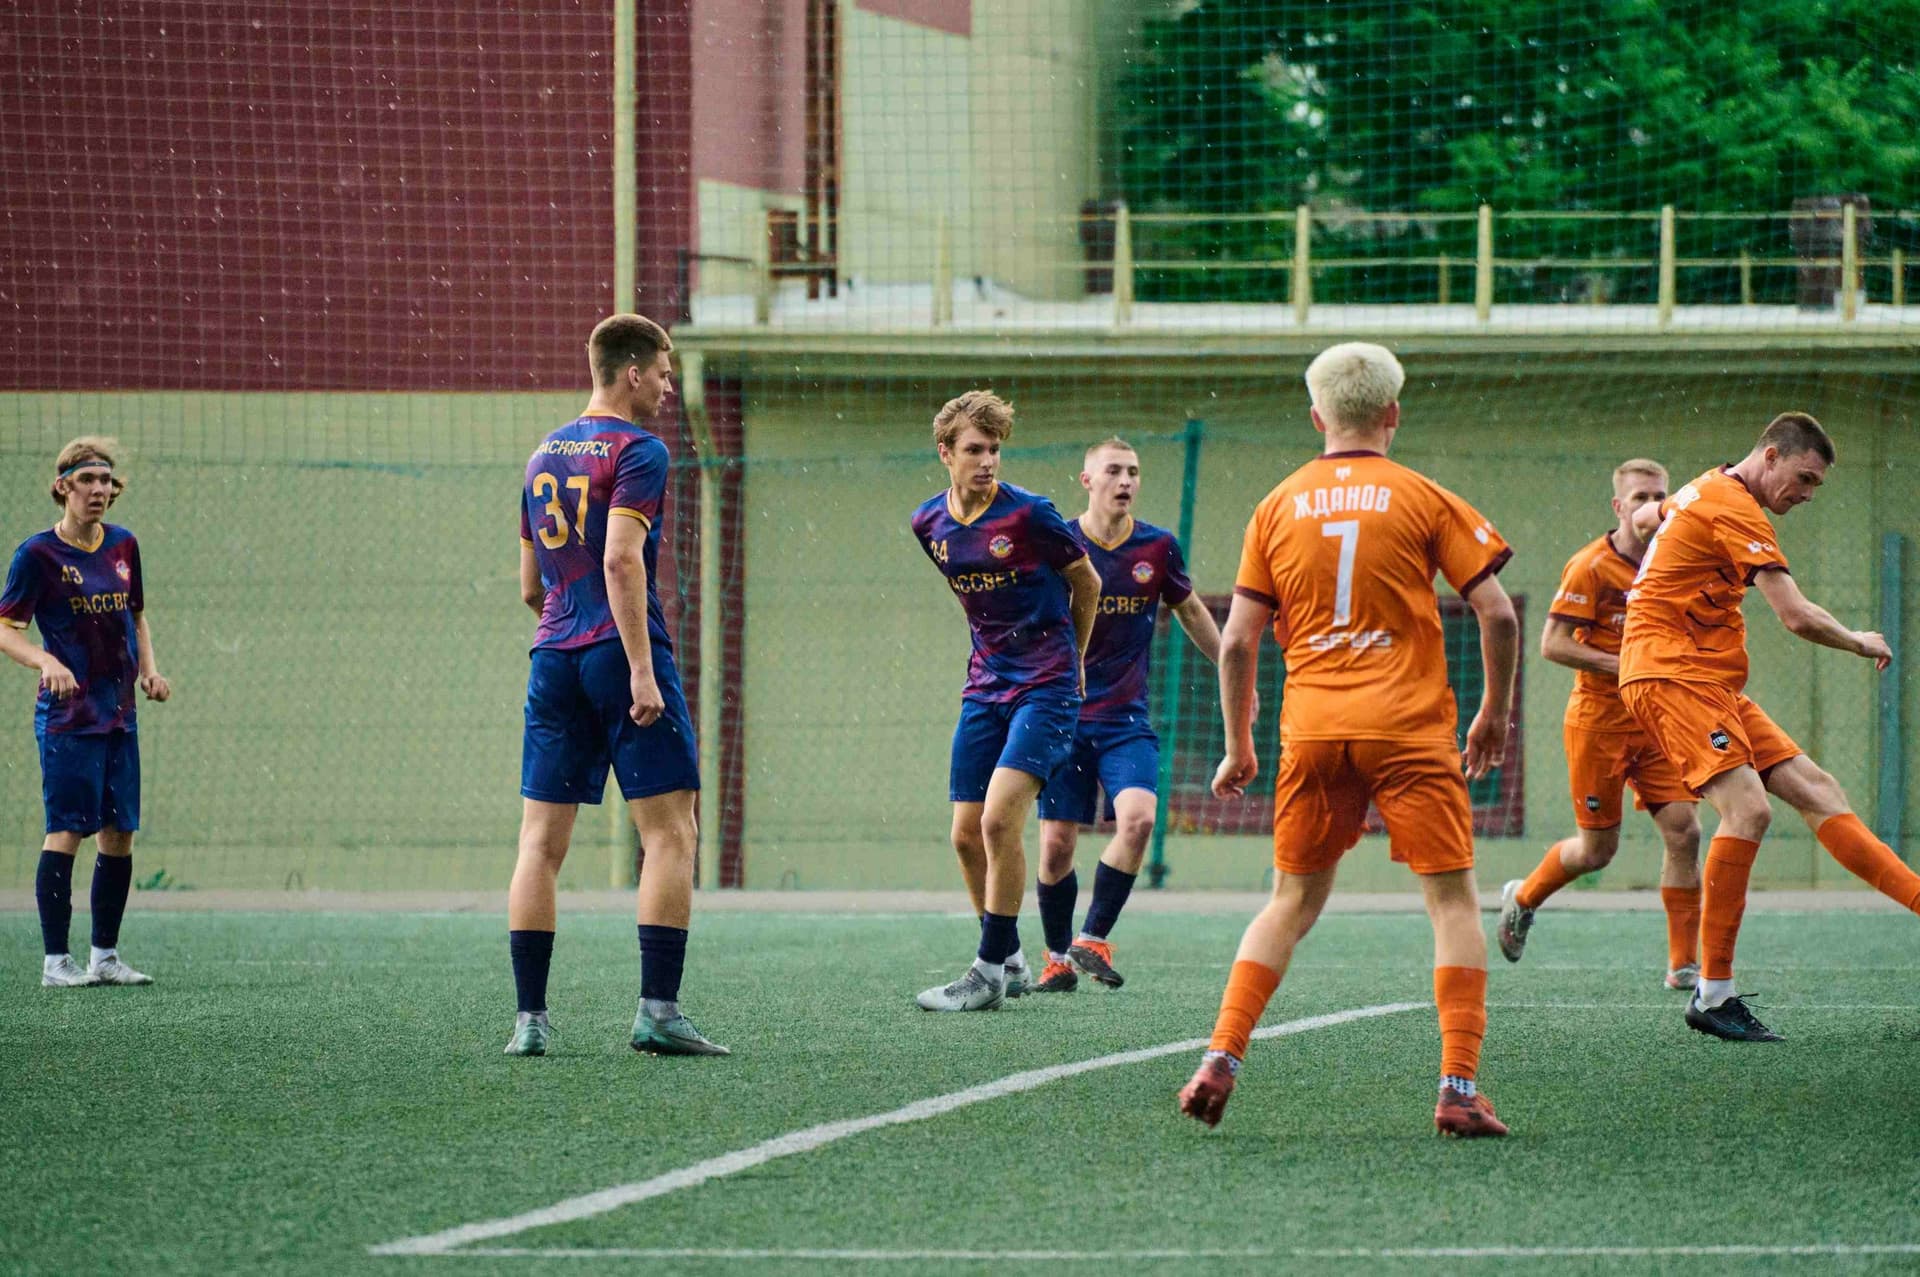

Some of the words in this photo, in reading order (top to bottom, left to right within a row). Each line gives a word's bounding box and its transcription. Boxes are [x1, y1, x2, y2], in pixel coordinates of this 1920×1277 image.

[532, 472, 590, 550] 37
[1293, 485, 1392, 520] ЖДАНОВ
[61, 564, 84, 585] 43
[1321, 519, 1360, 627] 7
